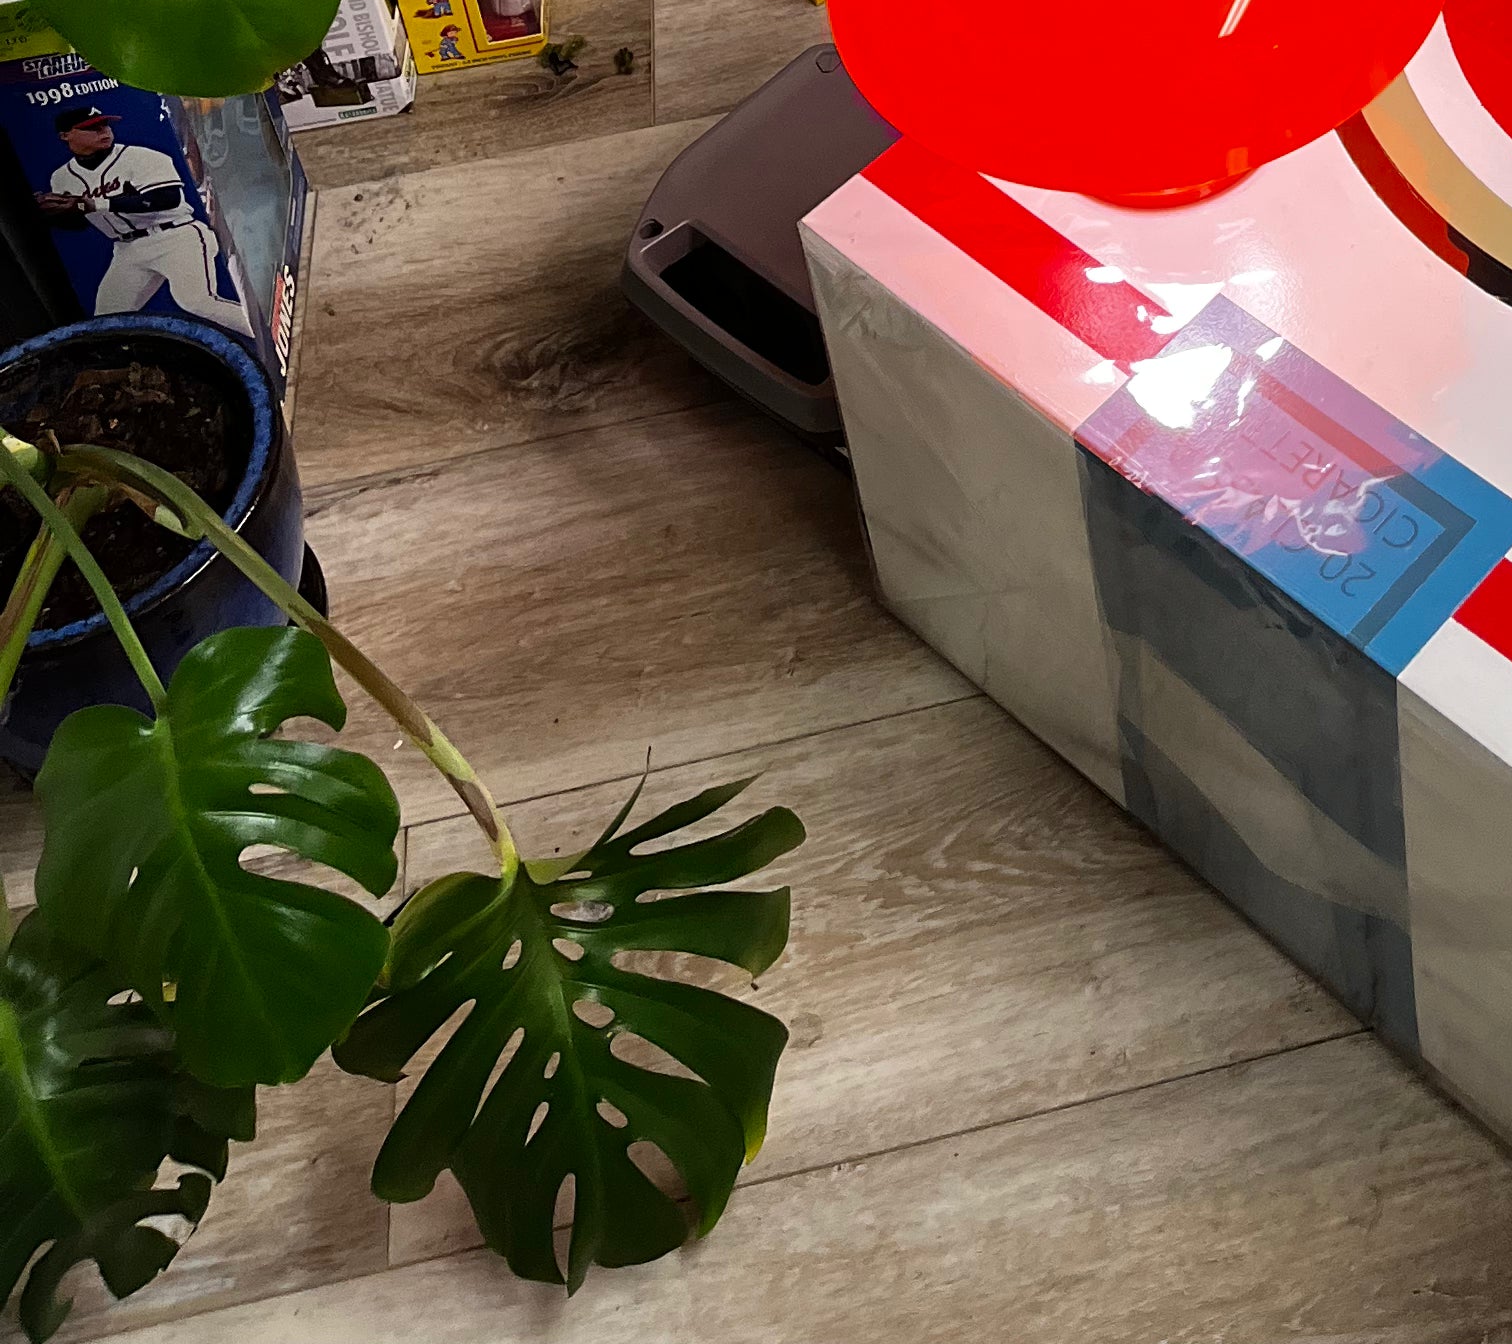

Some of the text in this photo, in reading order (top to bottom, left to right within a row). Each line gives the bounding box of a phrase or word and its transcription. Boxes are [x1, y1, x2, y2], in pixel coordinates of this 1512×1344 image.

[25, 77, 120, 107] 1998 EDITION
[353, 13, 382, 57] BISHOU
[374, 80, 399, 112] TATUE
[275, 263, 295, 377] JONES
[1318, 552, 1378, 598] 20
